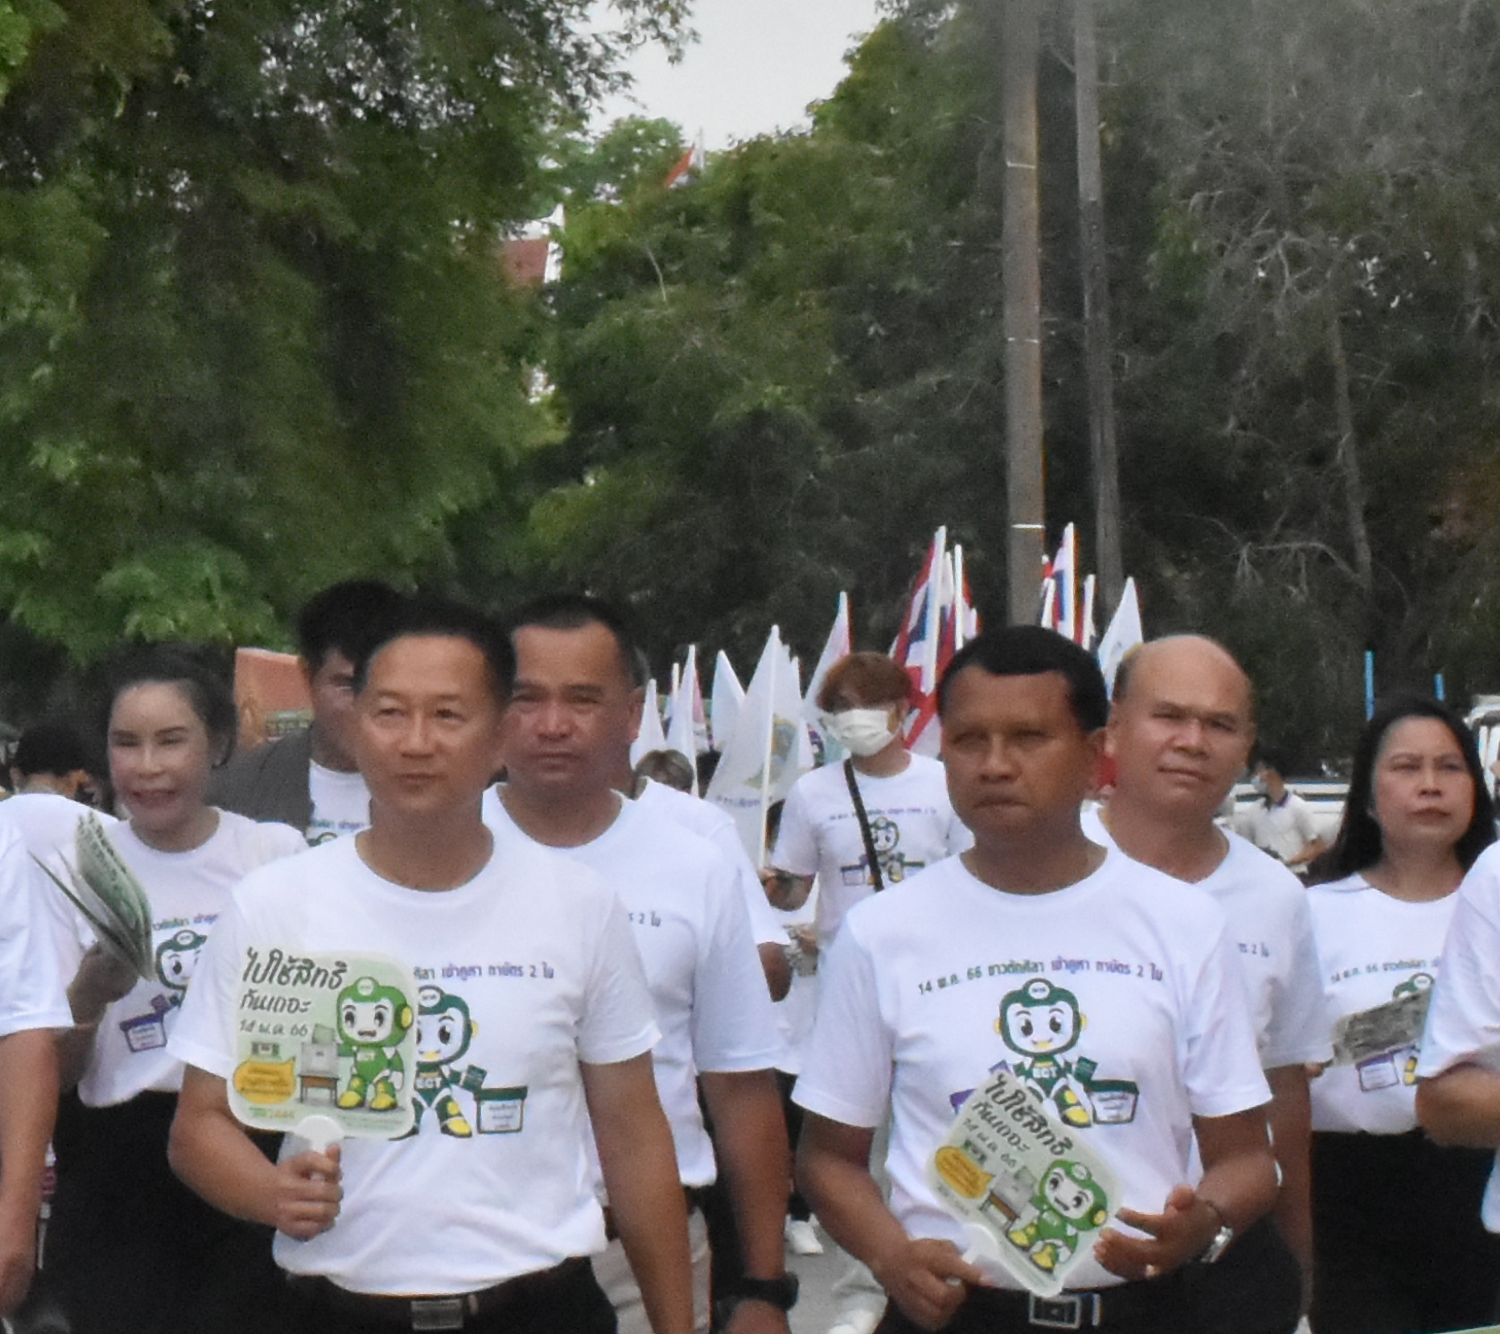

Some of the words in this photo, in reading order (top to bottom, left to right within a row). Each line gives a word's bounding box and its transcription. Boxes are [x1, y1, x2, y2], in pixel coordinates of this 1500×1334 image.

[242, 946, 348, 991] ไปใช้สิทธิ
[529, 965, 536, 978] 2
